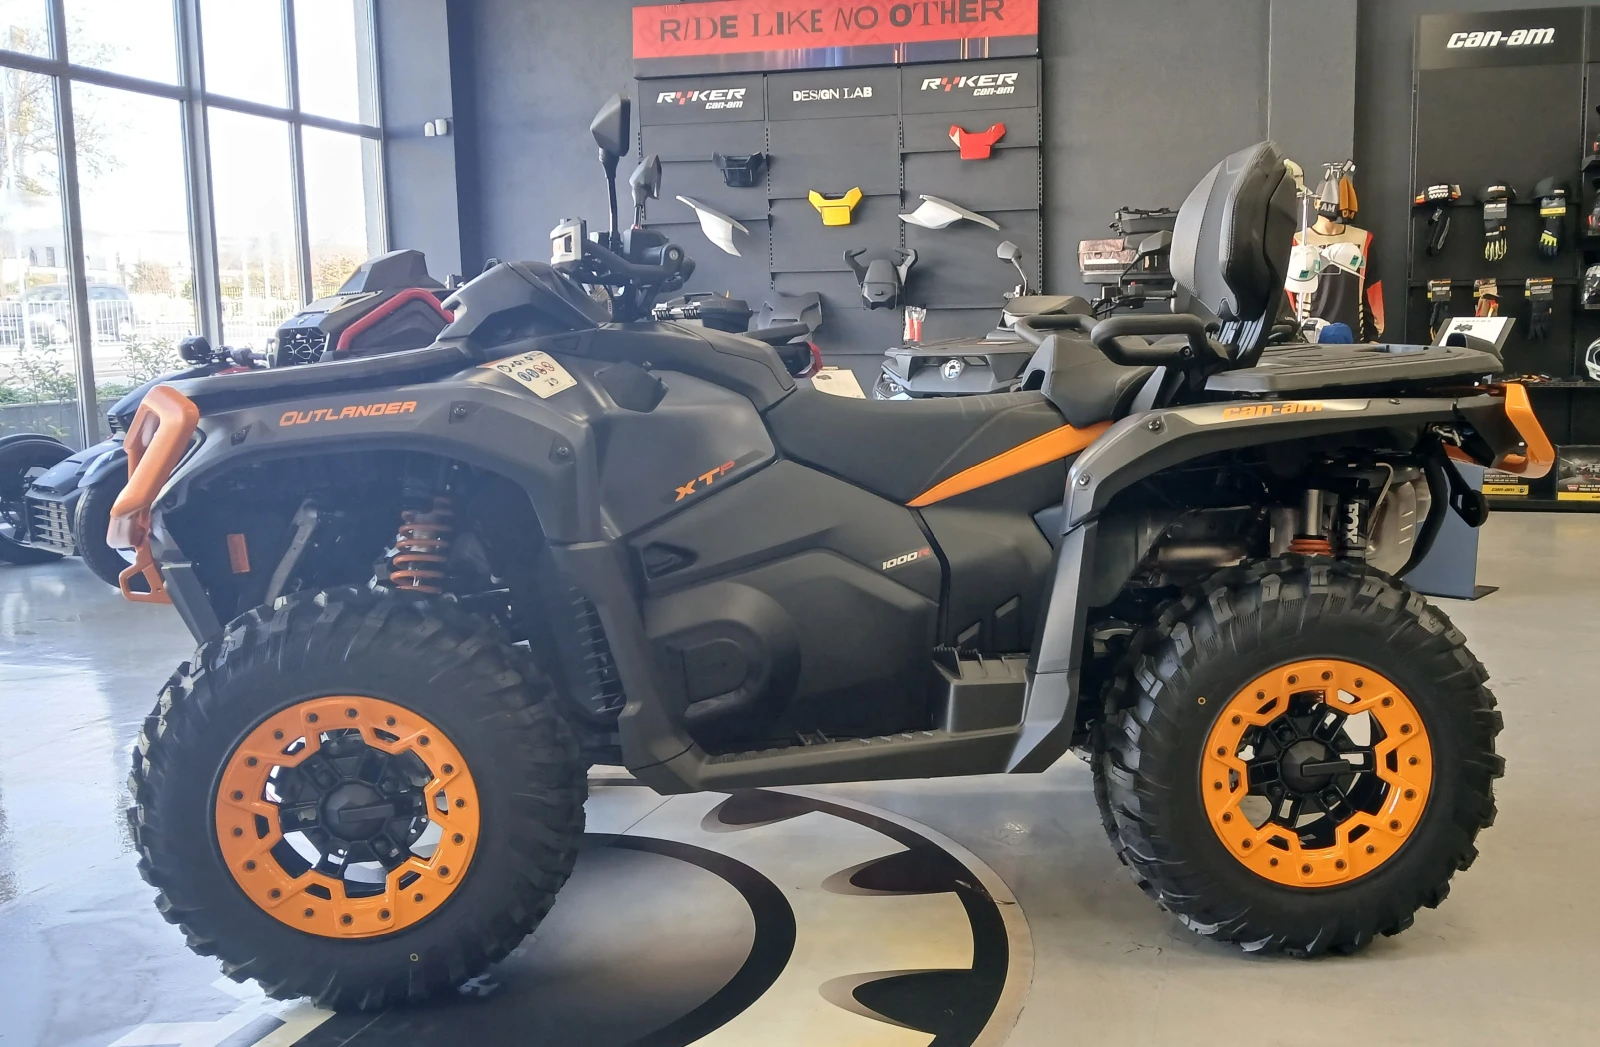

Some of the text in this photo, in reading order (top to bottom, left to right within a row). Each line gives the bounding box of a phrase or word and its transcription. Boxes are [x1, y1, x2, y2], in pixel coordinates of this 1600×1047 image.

[660, 0, 1005, 42] RIDE LIKE NO OTHER
[920, 72, 1019, 92] RYKER
[973, 86, 1015, 97] can-am
[656, 88, 746, 105] RYKER
[792, 86, 873, 101] DESIGN LAB
[705, 100, 744, 110] can-am
[279, 400, 417, 427] OUTLANDER
[1222, 401, 1324, 420] can-am
[882, 547, 931, 571] 1000R
